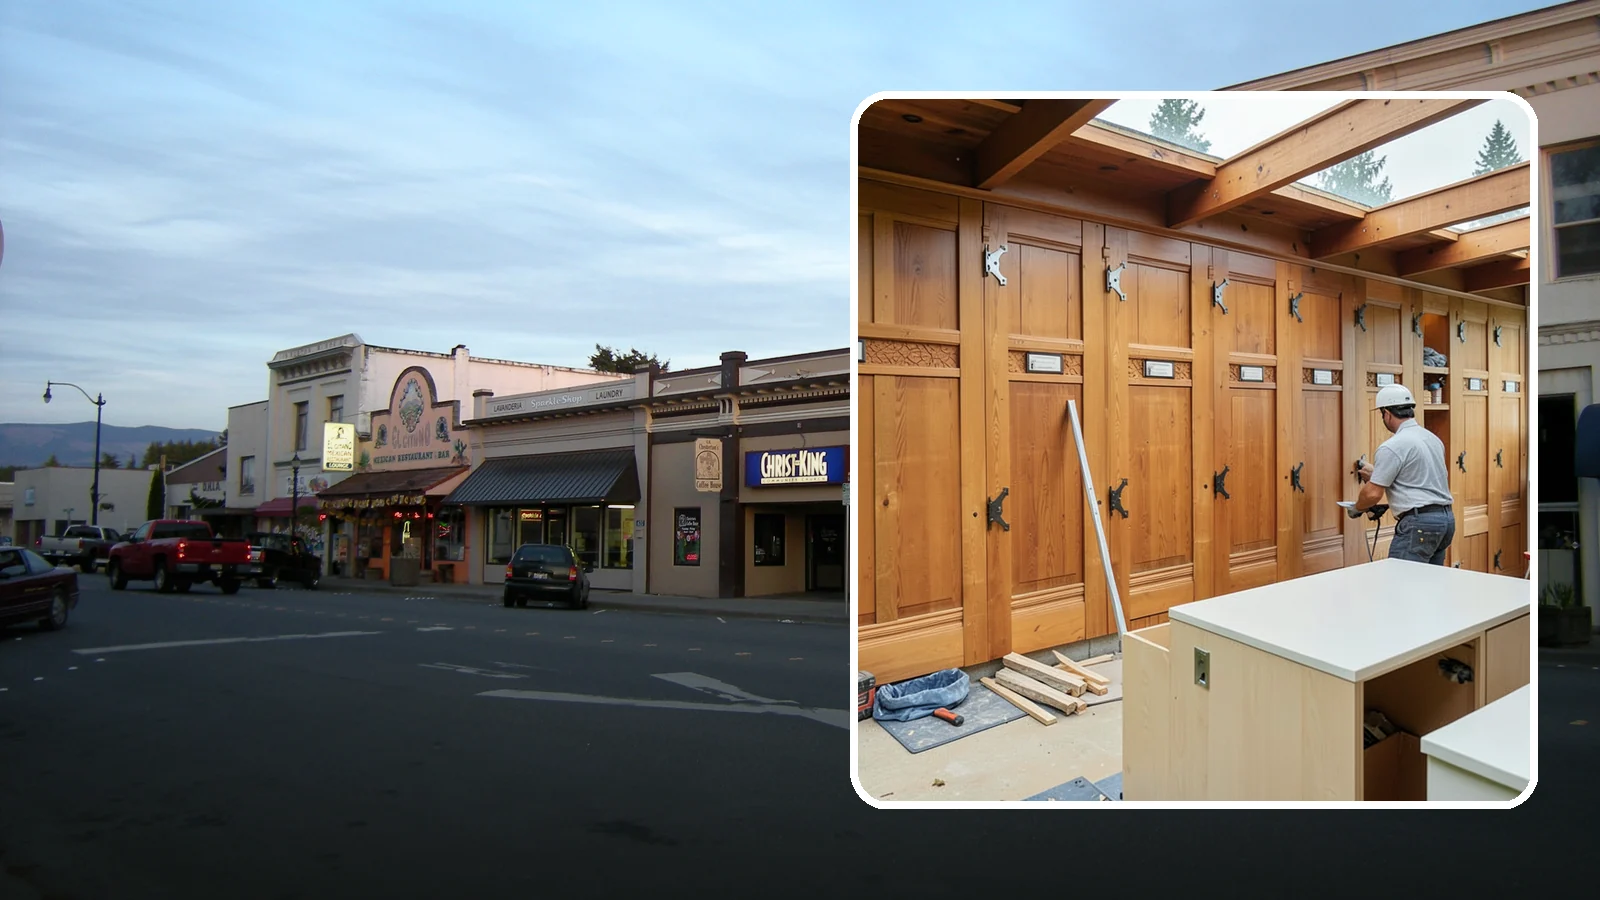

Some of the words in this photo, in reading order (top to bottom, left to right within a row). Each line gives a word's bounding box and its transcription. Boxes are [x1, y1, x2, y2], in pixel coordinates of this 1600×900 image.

[530, 396, 560, 409] Sparkle
[562, 394, 582, 404] Shop
[596, 389, 624, 400] LAUNDRY
[493, 402, 523, 412] LAVANDERIA
[392, 426, 402, 450] EL
[374, 454, 396, 464] MEXICAN
[398, 451, 433, 462] RESTAURANT
[438, 450, 450, 459] BAR
[760, 452, 797, 478] CHRIST
[799, 450, 827, 476] KING
